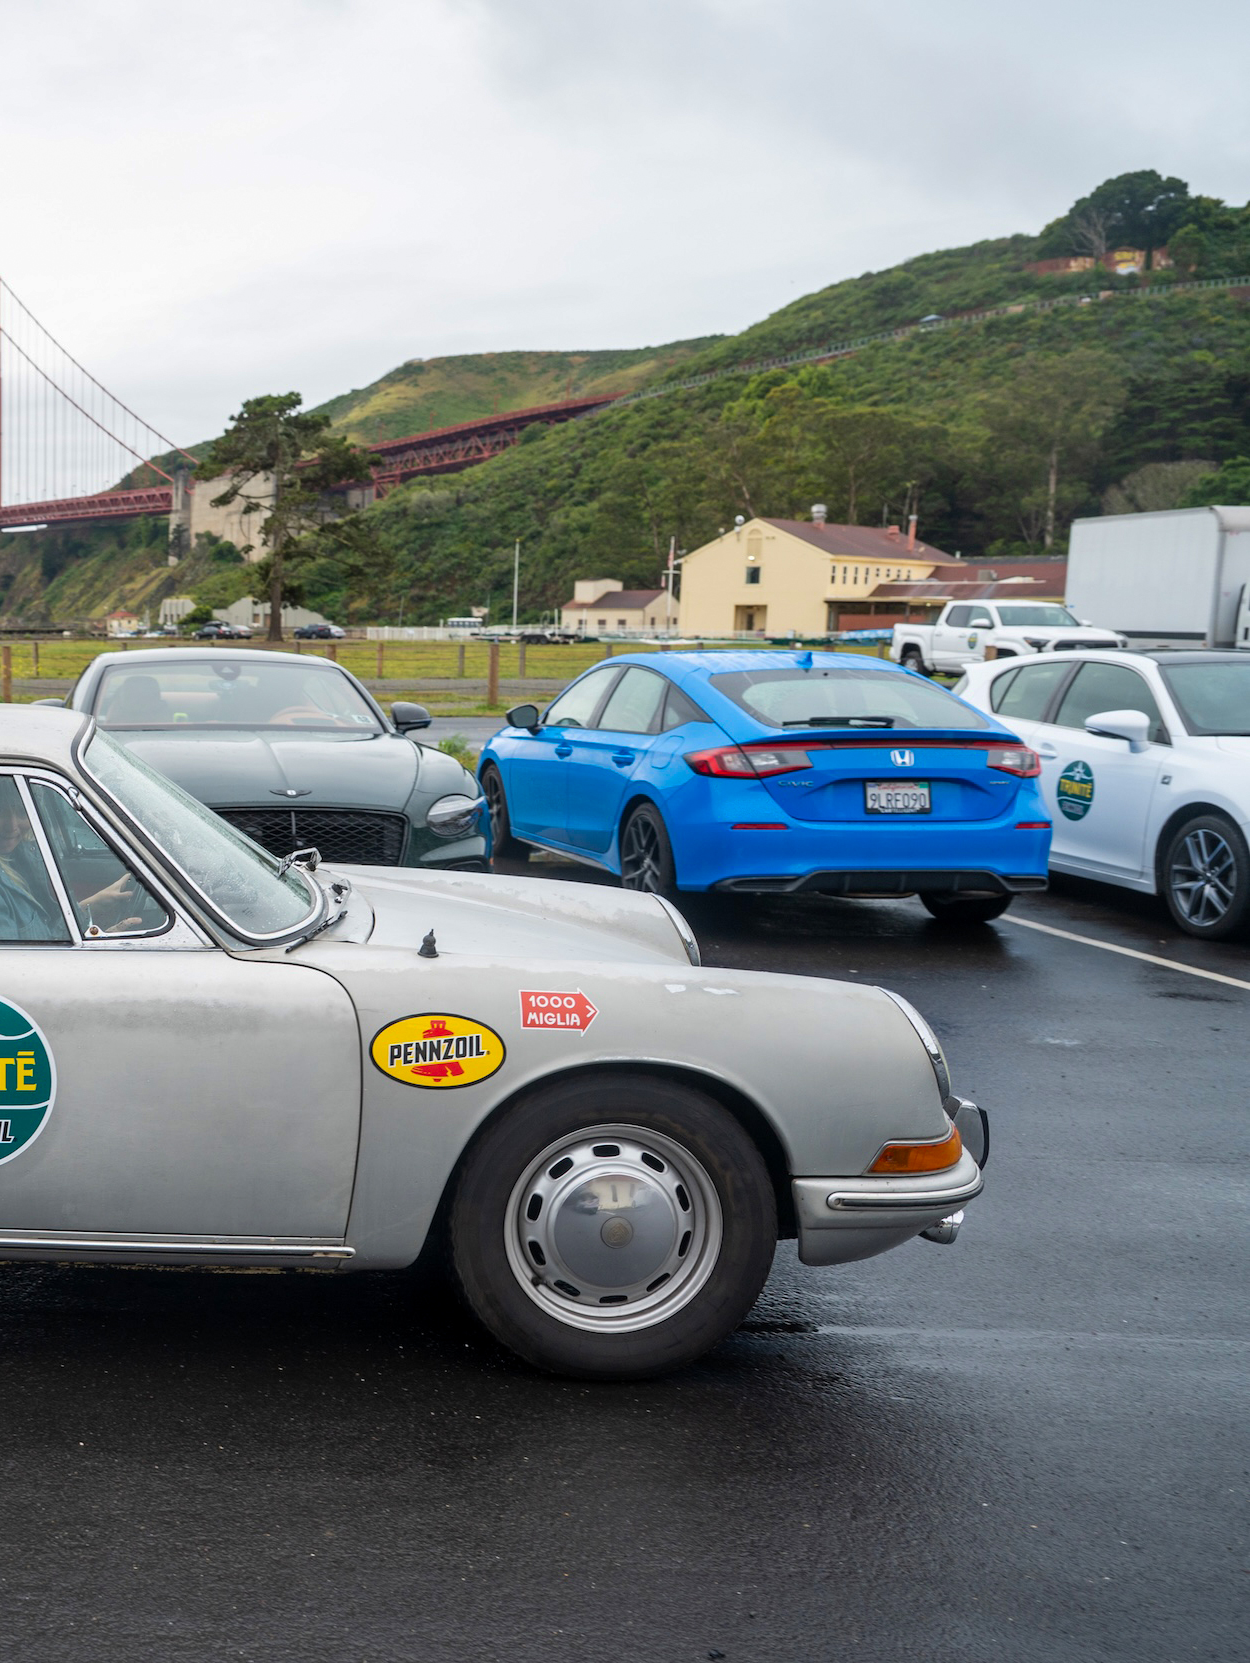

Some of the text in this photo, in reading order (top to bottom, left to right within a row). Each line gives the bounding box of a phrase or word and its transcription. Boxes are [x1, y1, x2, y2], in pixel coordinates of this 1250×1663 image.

[870, 793, 927, 809] 9LRF090
[529, 995, 576, 1009] 1000
[527, 1012, 581, 1027] MIGLIA
[388, 1034, 487, 1068] PENNZOIL
